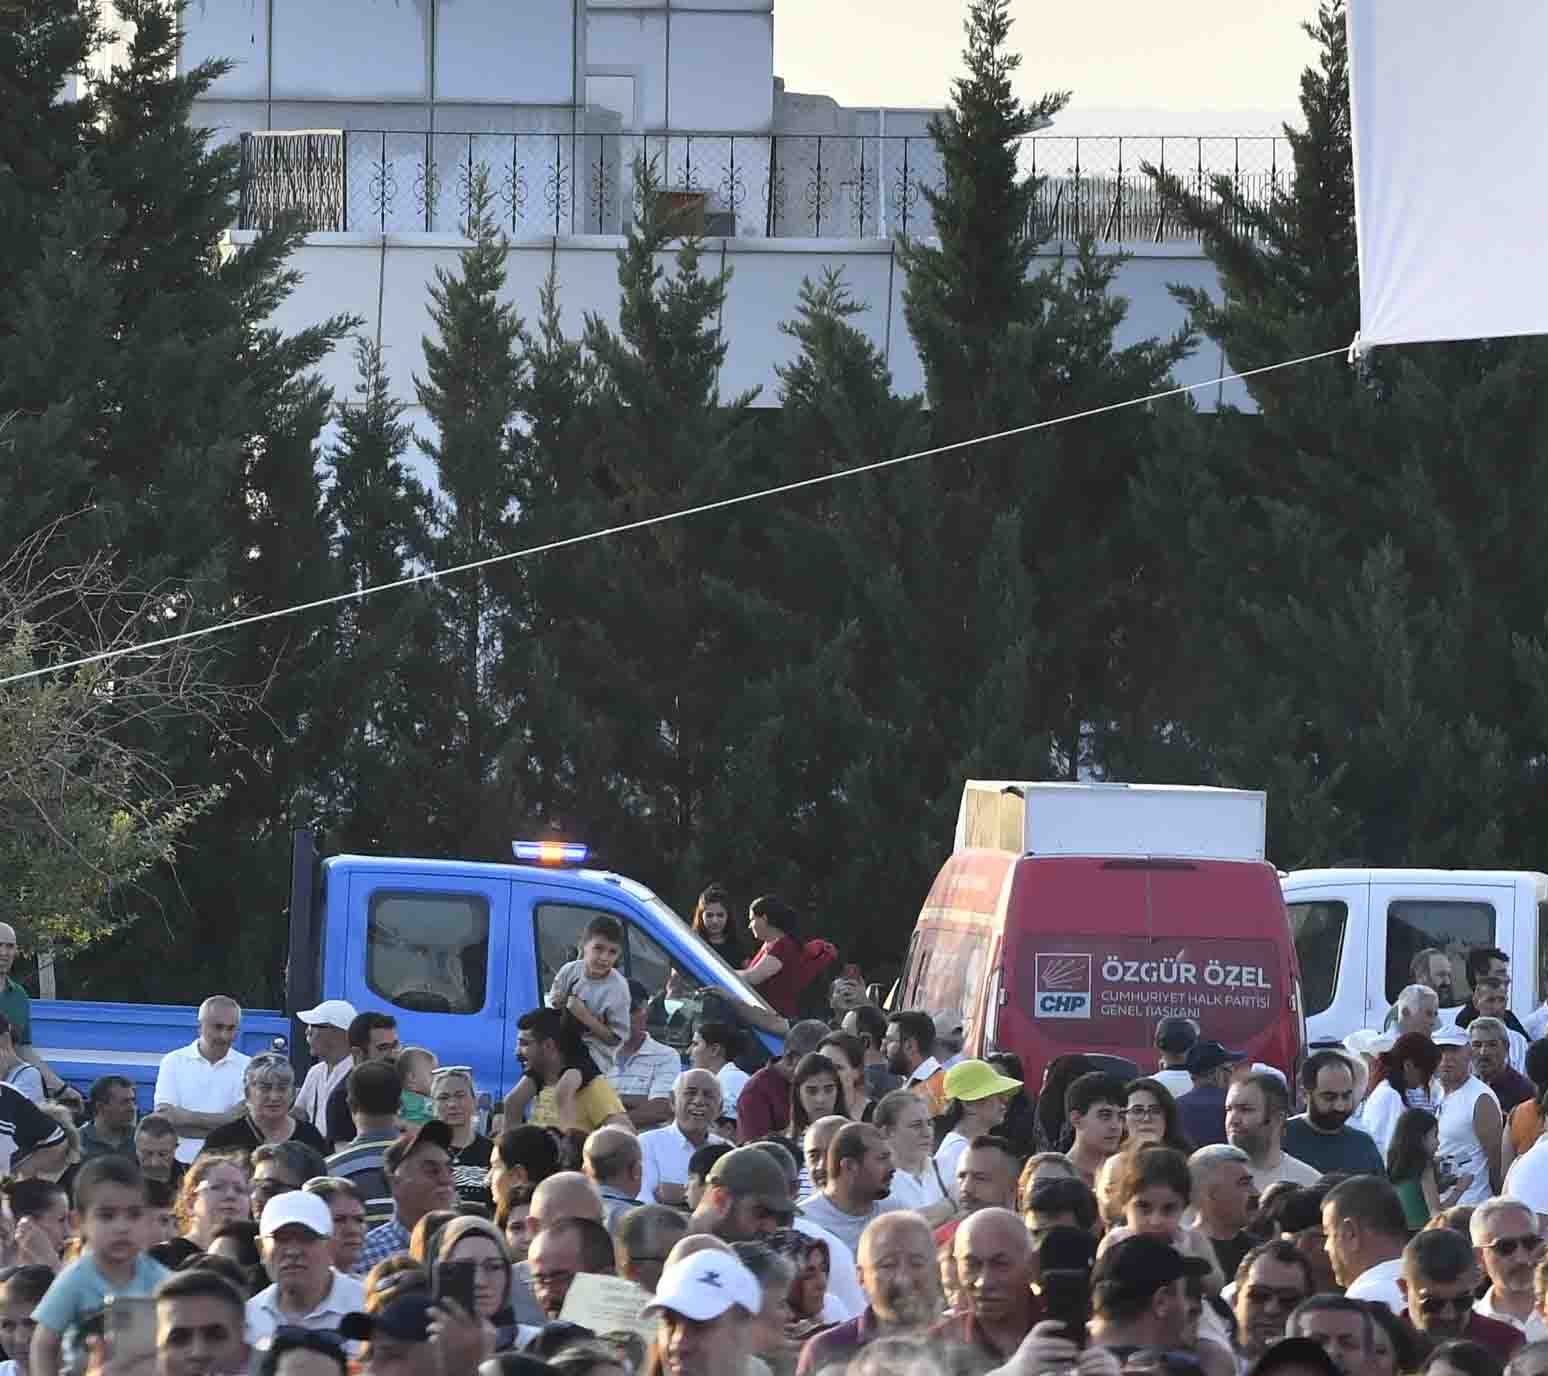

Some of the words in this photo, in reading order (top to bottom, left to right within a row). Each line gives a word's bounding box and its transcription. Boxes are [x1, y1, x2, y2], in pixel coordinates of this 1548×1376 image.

[1102, 955, 1197, 985] ÖZGÜR
[1203, 959, 1272, 989] ÖZEL
[1040, 995, 1086, 1013] CHP
[1188, 993, 1223, 1006] HALK
[1101, 1004, 1143, 1017] GENEL
